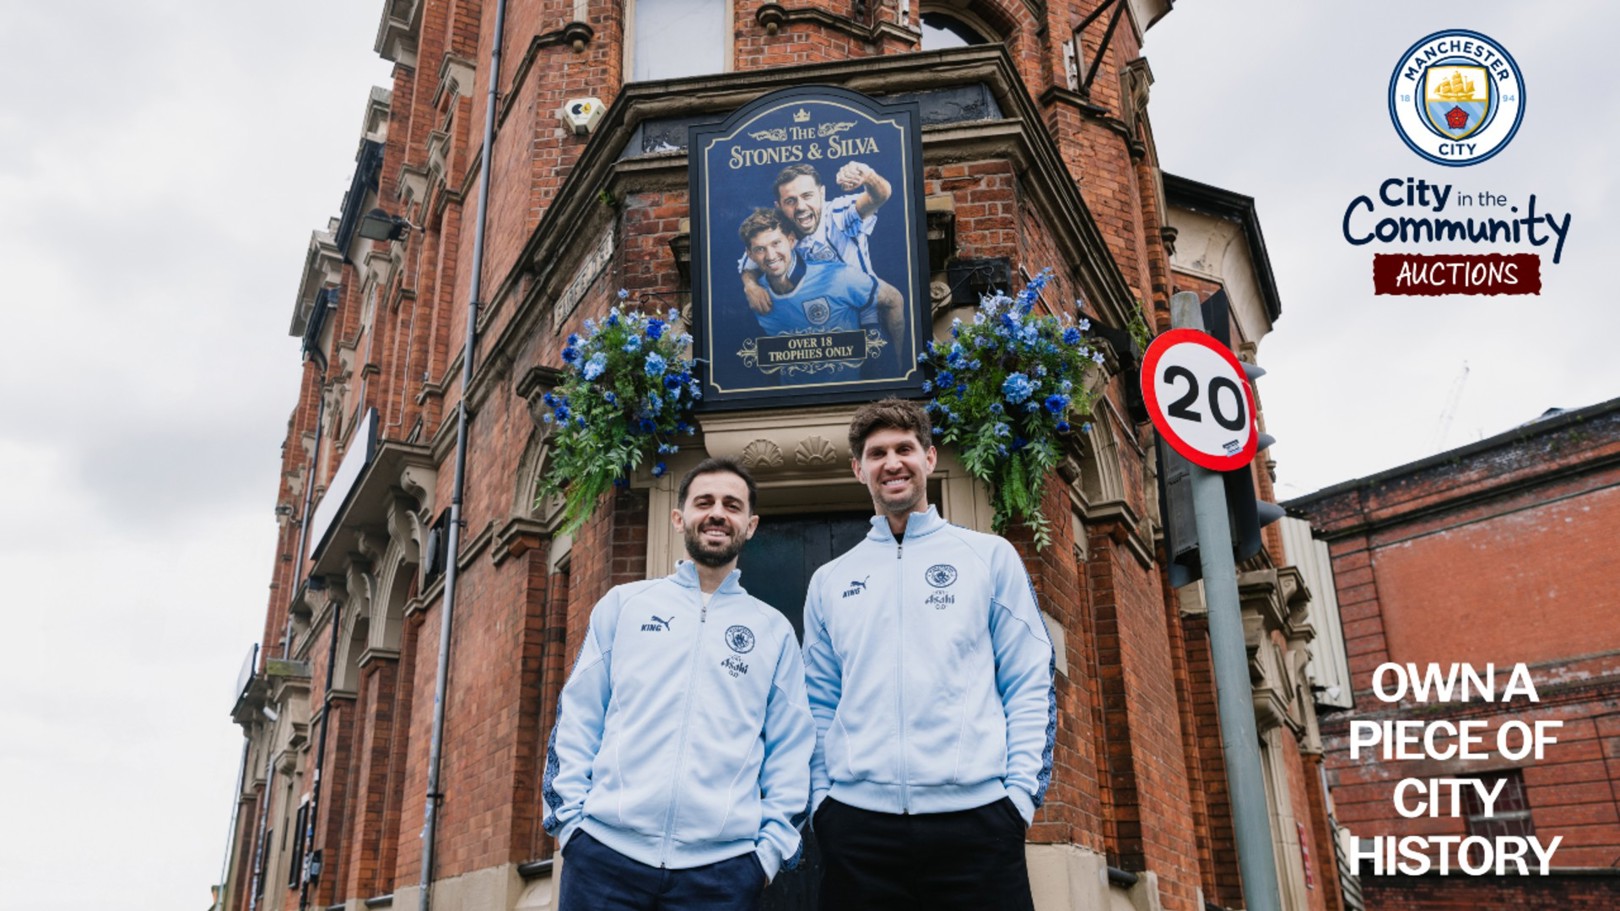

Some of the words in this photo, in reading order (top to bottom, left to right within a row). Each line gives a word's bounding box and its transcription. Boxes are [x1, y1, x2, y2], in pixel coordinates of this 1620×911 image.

[789, 126, 816, 141] THE
[729, 145, 803, 169] STONES
[807, 143, 823, 161] &
[827, 135, 879, 159] SILVA
[788, 337, 818, 349] OVER
[821, 336, 833, 347] 18
[768, 347, 823, 362] TROPHIES
[825, 345, 854, 358] ONLY
[1163, 365, 1246, 431] 20
[640, 624, 662, 632] KING
